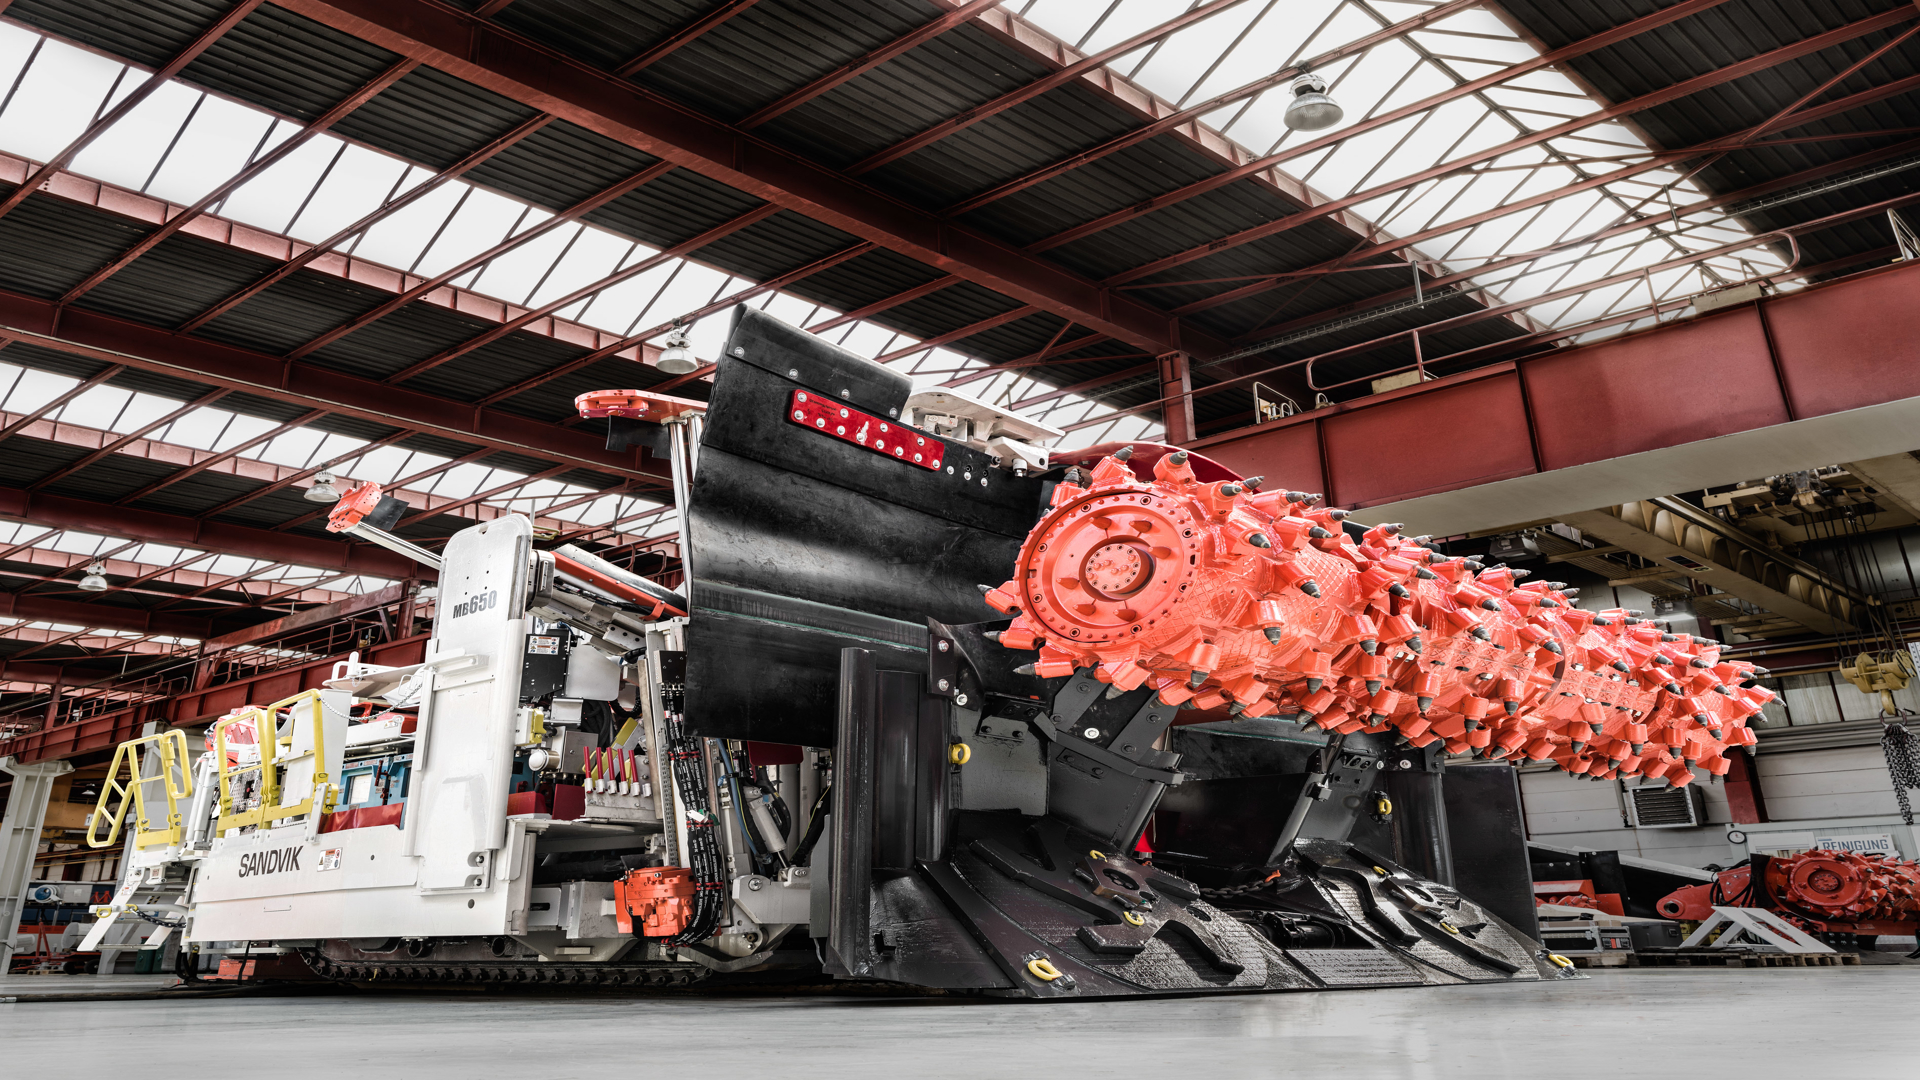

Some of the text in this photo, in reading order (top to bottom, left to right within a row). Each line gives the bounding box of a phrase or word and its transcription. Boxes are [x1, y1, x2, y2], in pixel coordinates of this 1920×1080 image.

[453, 590, 498, 619] MB650
[1822, 839, 1889, 850] REINIGUNG
[238, 845, 304, 878] SANDVIK
